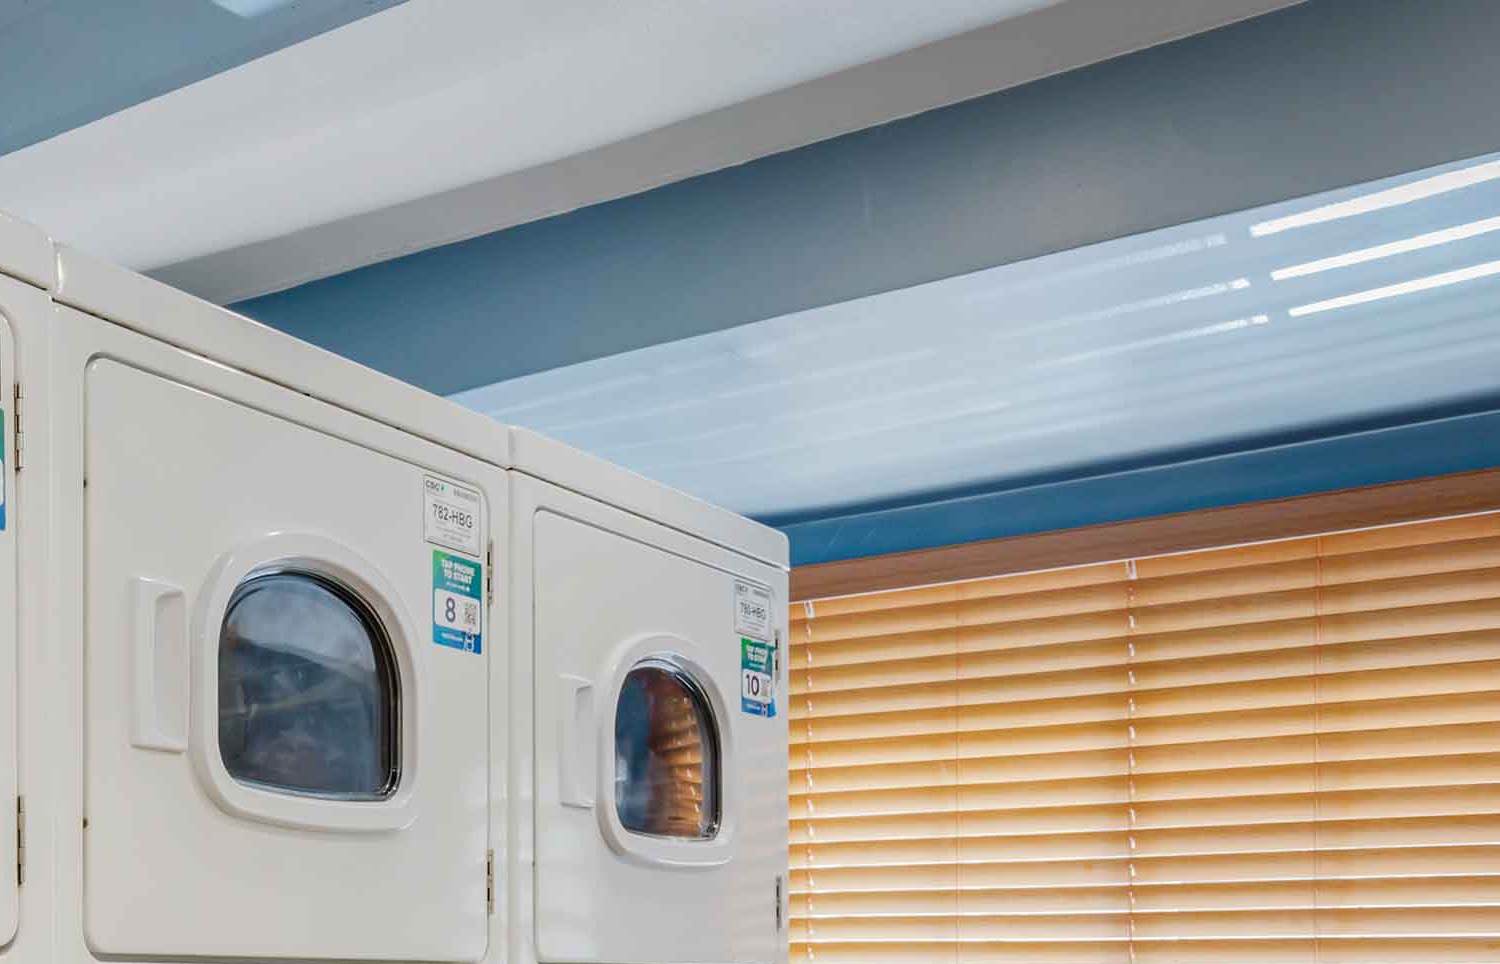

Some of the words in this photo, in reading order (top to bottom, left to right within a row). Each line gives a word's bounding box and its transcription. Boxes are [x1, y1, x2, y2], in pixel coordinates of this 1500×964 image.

[432, 503, 473, 528] 782-HBG
[445, 597, 456, 622] 8
[746, 674, 760, 696] 10
